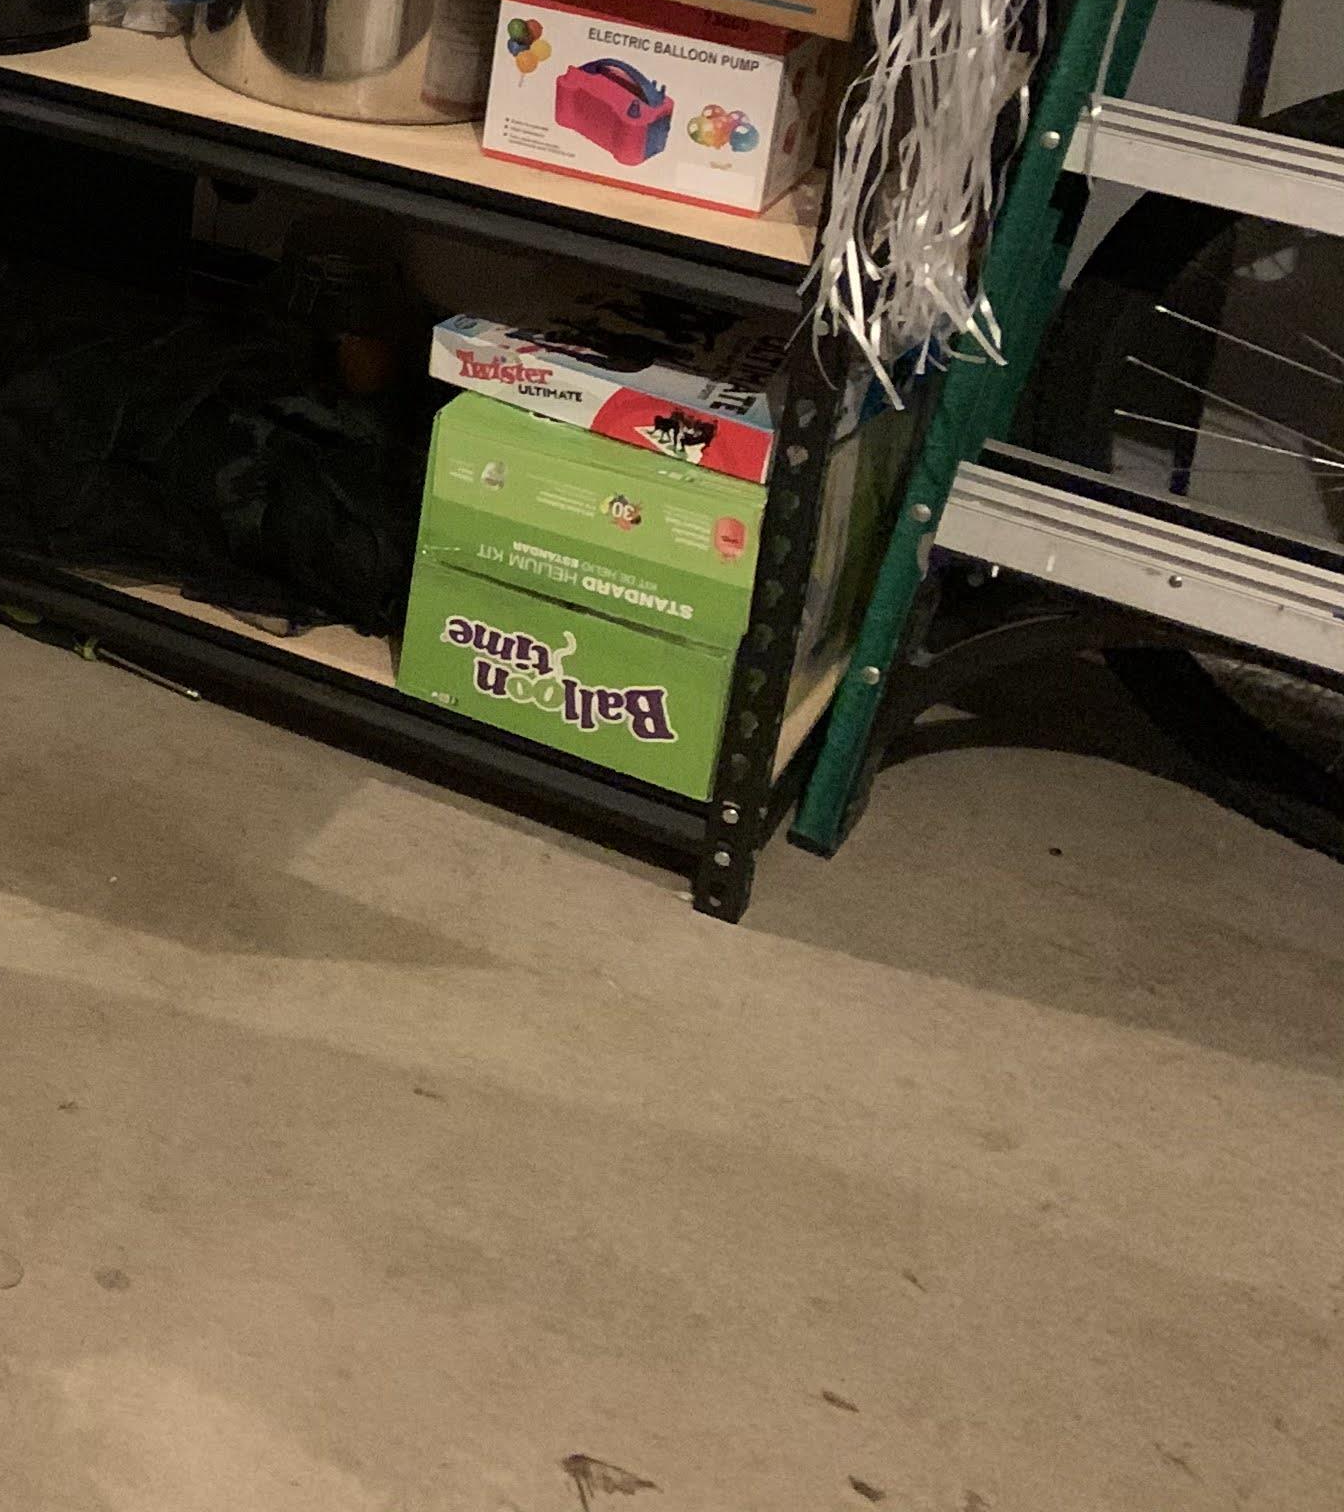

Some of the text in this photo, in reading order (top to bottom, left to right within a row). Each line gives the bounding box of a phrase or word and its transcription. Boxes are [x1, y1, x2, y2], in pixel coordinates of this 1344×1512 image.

[588, 27, 760, 72] ELECTRIC BALLOON PUMP
[456, 348, 553, 385] Twister
[518, 383, 583, 404] ULTIMATE
[612, 501, 635, 521] 30
[476, 543, 694, 620] STANDARD HELIUM KIT
[446, 615, 556, 677] time
[474, 658, 679, 743] Balloon
